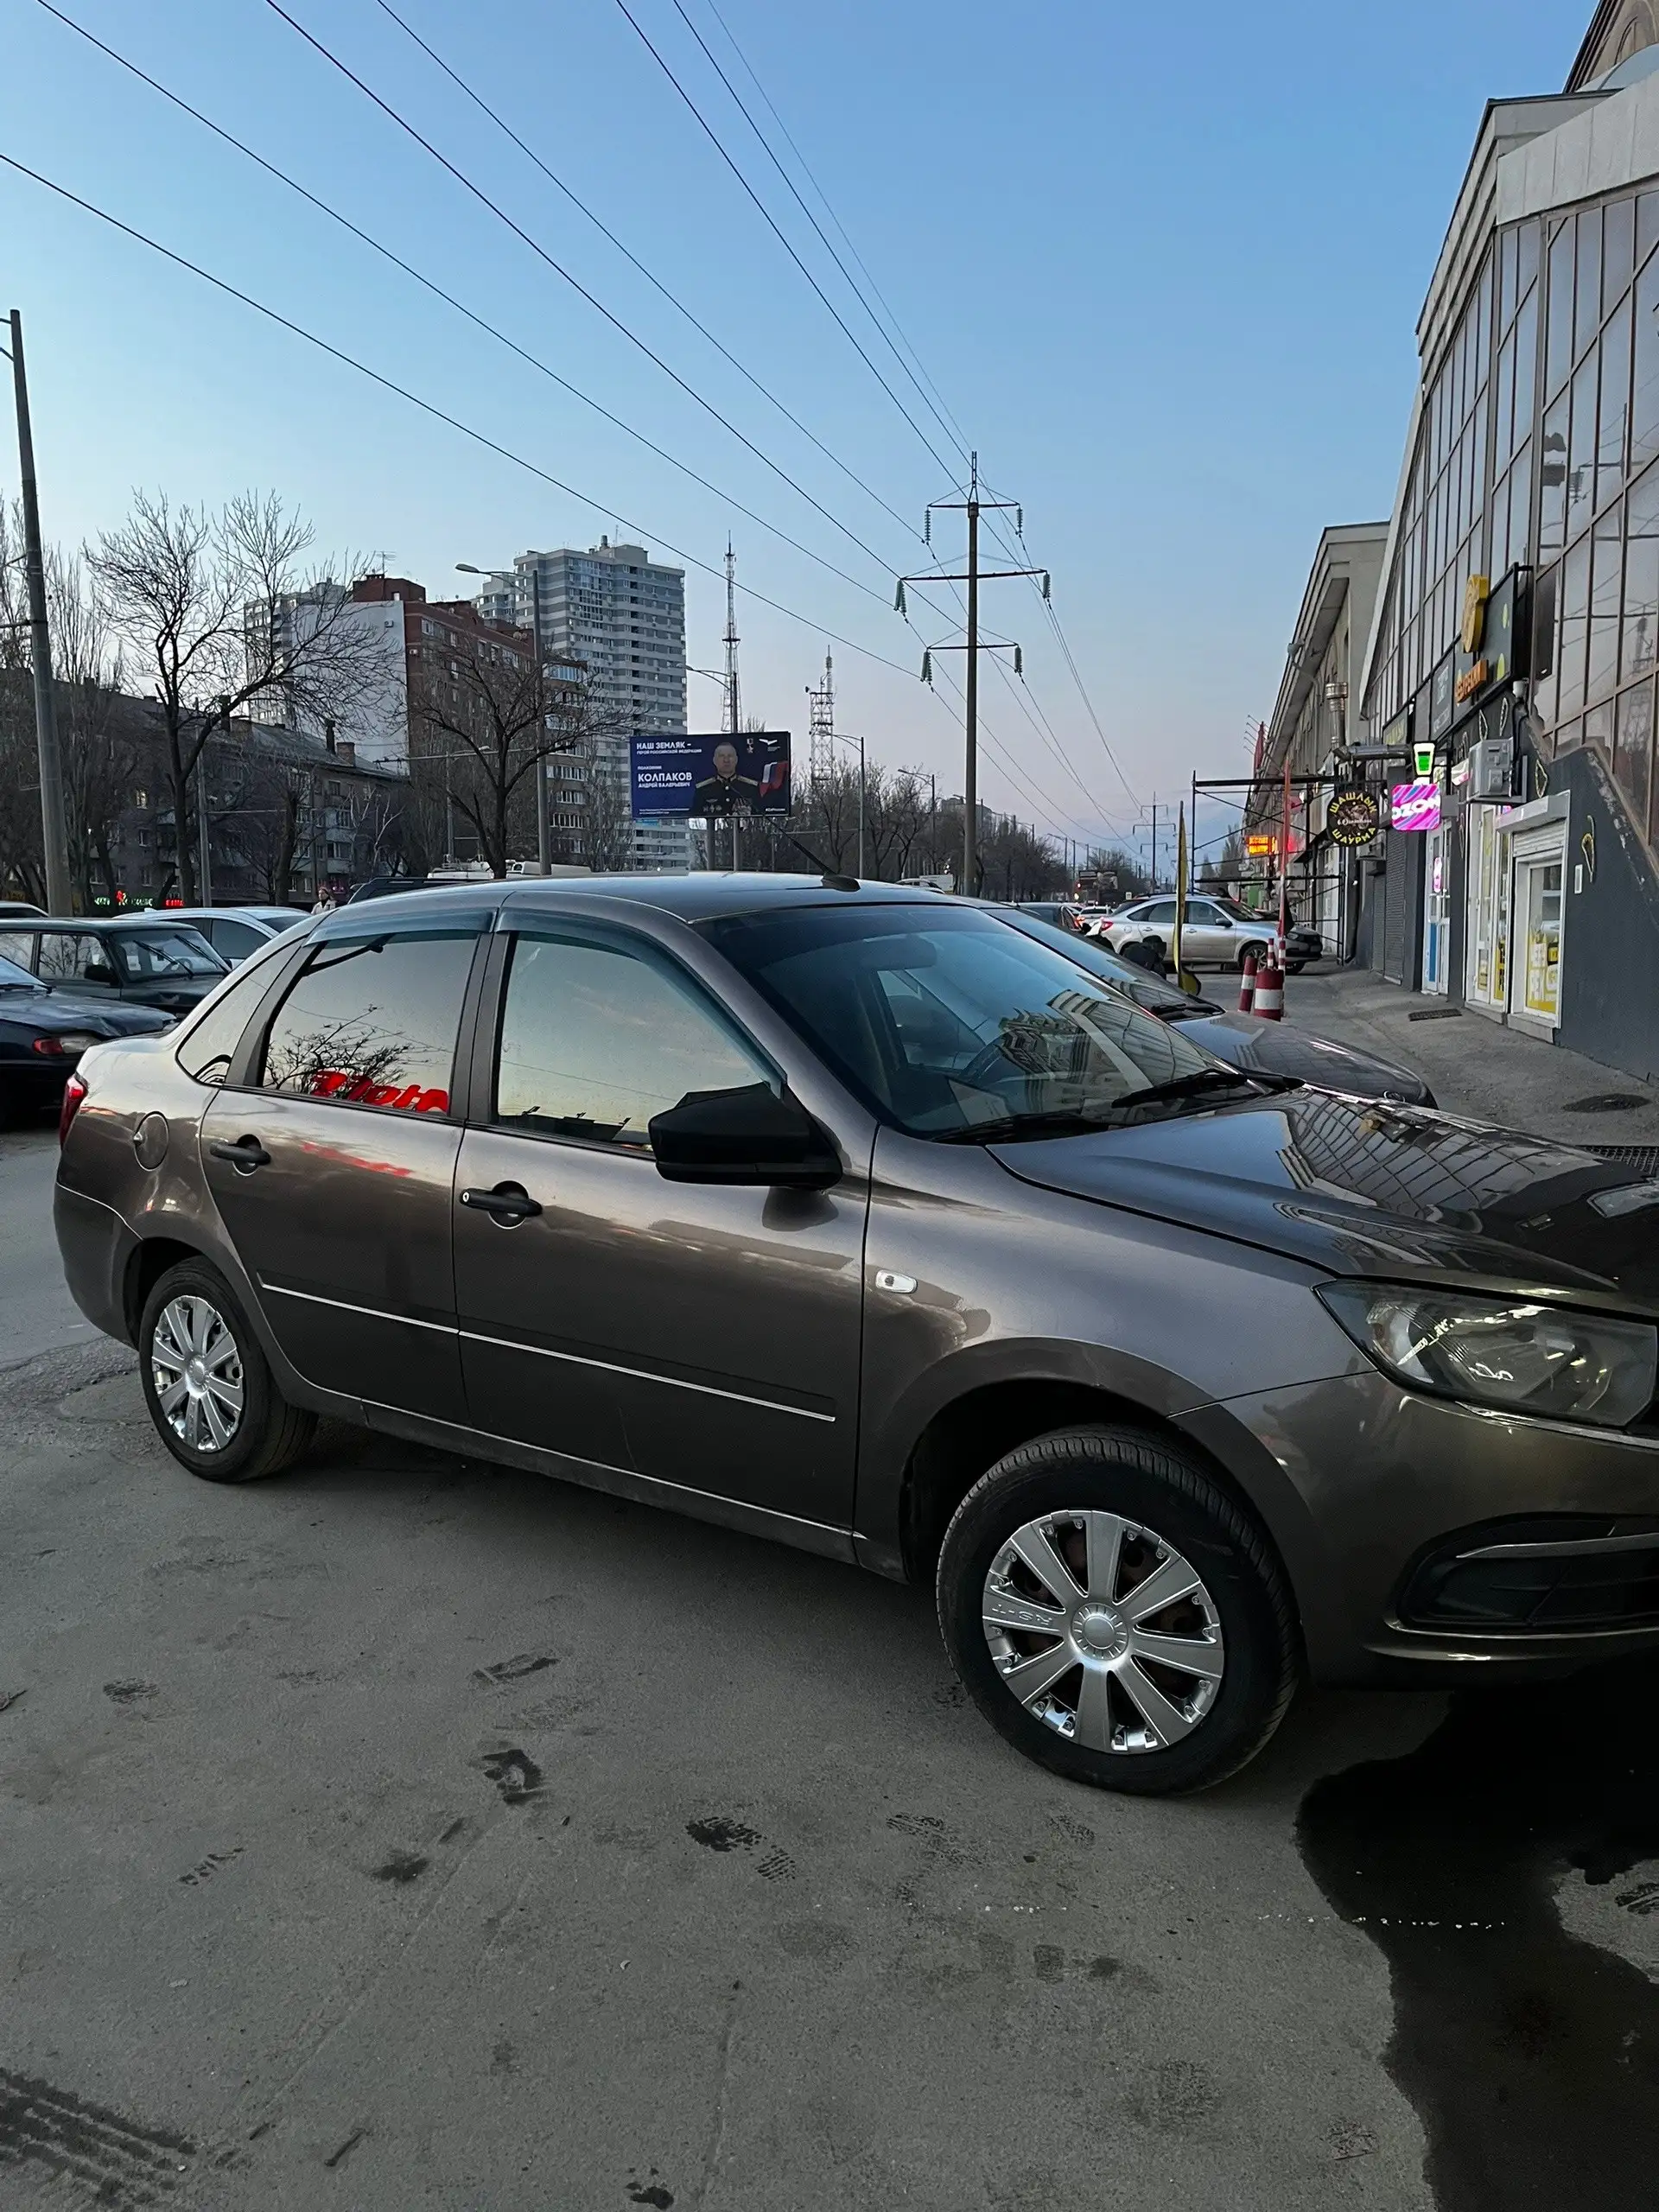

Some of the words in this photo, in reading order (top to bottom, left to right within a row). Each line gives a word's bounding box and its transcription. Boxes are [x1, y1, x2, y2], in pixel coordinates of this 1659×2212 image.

[638, 772, 692, 782] КОЛПАКОВ
[1329, 791, 1377, 813] ШАШЛЫК
[1332, 827, 1376, 844] ШАУРМА
